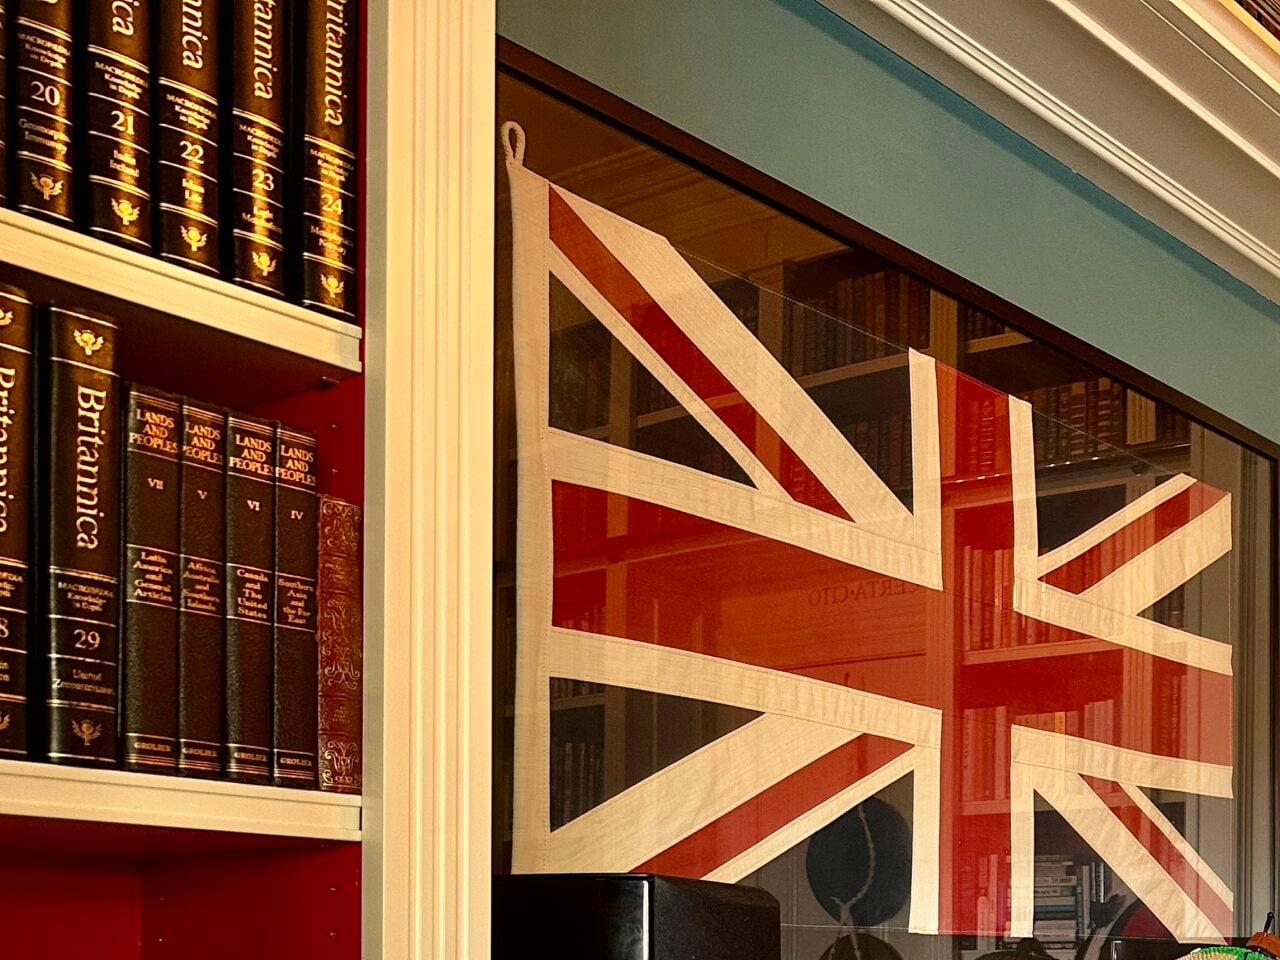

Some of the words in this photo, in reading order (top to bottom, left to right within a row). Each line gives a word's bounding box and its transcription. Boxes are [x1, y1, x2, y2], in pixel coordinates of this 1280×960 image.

[253, 0, 277, 99] tannica
[324, 0, 348, 126] ritannica
[30, 81, 60, 106] 20
[111, 110, 136, 135] 21
[179, 140, 205, 164] 22
[252, 168, 275, 191] 23
[321, 194, 344, 216] 24
[136, 408, 175, 429] LANDS
[143, 424, 169, 439] AND
[185, 421, 221, 441] LANDS
[129, 432, 178, 454] PEOPLES
[191, 436, 216, 451] AND
[235, 434, 272, 452] LANDS
[241, 448, 266, 462] AND
[280, 444, 314, 463] LANDS
[75, 384, 108, 550] Britannica
[285, 459, 309, 472] AND
[147, 477, 164, 490] VII
[197, 490, 208, 500] V
[247, 500, 260, 511] VI
[290, 510, 304, 520] IV
[133, 588, 173, 602] Articles
[243, 589, 263, 600] The
[237, 606, 267, 619] States
[73, 629, 101, 650] 29
[133, 742, 171, 752] GROLIER
